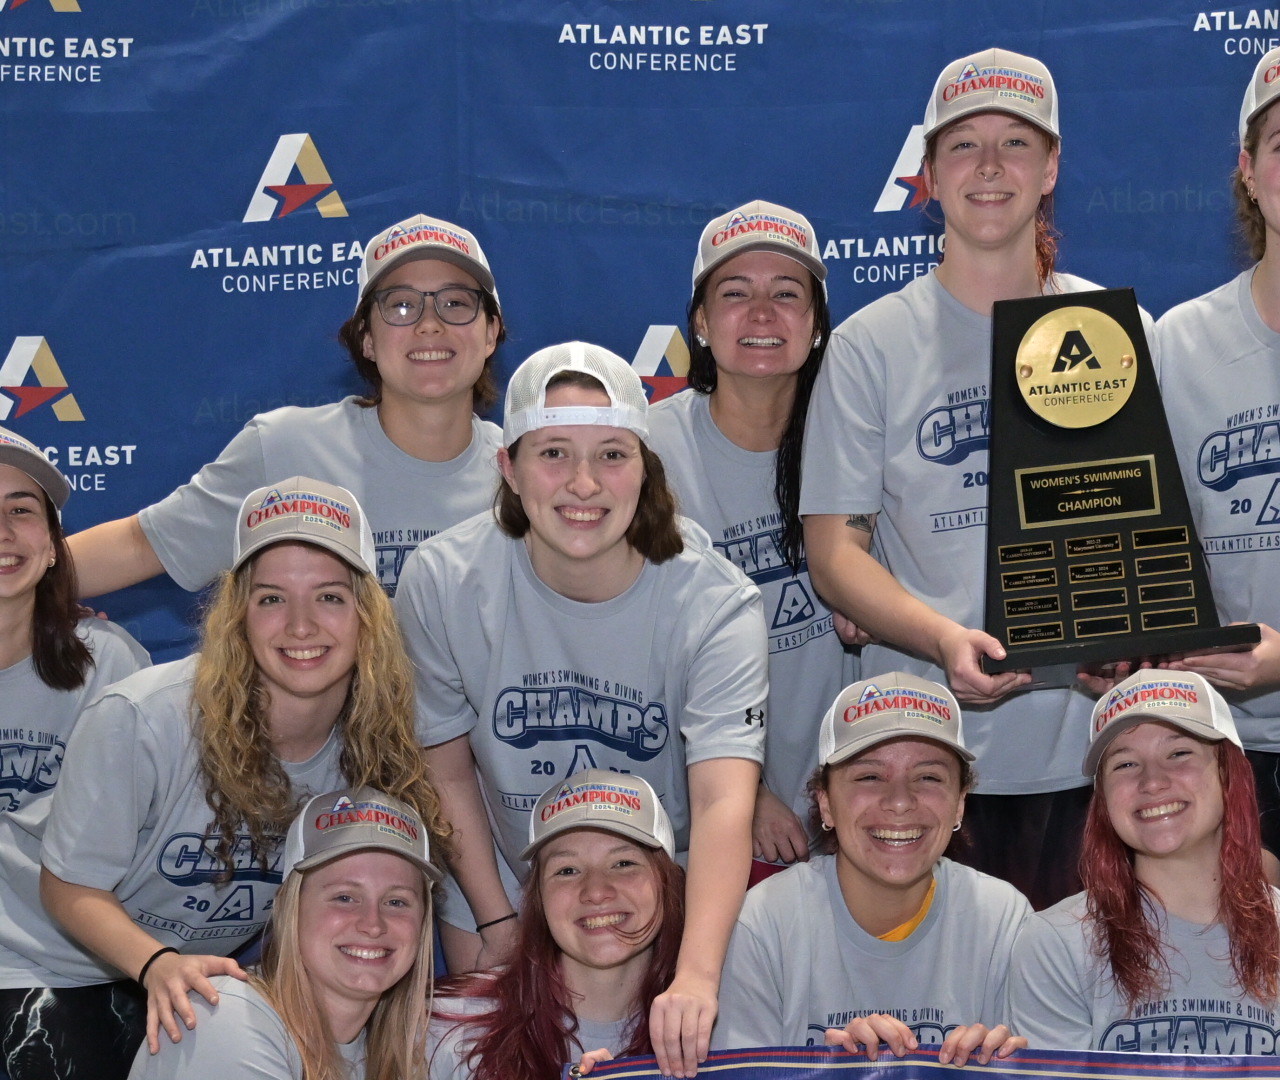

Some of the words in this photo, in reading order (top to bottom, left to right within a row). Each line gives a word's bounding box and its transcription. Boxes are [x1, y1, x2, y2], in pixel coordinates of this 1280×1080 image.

[559, 24, 690, 45] ATLANTIC
[700, 24, 768, 45] EAST
[65, 38, 133, 58] EAST
[590, 52, 736, 71] CONFERENCE
[942, 76, 1043, 101] CHAMPIONS
[373, 231, 470, 261] CHAMPIONS
[711, 220, 806, 248] CHAMPIONS
[191, 244, 322, 268] ATLANTIC
[332, 243, 364, 264] EA
[221, 267, 362, 294] CONFERENC
[1028, 381, 1092, 398] ATLANTIC
[1095, 379, 1127, 390] EAST
[1043, 392, 1115, 408] CONFERENCE
[1226, 406, 1263, 429] WOMEN'S
[68, 445, 137, 466] EAST
[1030, 475, 1080, 488] WOMEN'S
[1084, 468, 1141, 483] SWIMMING
[246, 500, 350, 529] CHAMPIONS
[1058, 496, 1121, 512] CHAMPION
[1229, 498, 1252, 515] 20
[522, 669, 555, 687] WOMEN'S
[558, 669, 599, 691] SWIMMING
[604, 682, 611, 693] &
[615, 683, 644, 704] DIVING
[492, 686, 670, 756] CHAMPS
[843, 695, 950, 723] CHAMPIONS
[1095, 687, 1198, 733] CHAMPIONS
[530, 759, 556, 776] 20
[541, 789, 641, 821] CHAMPIONS
[315, 810, 417, 841] CHAMPIONS
[1134, 1000, 1177, 1019] WOMEN'S
[1181, 998, 1231, 1014] SWIMMING
[1236, 1002, 1243, 1015] &
[1247, 1005, 1276, 1027] DIVING
